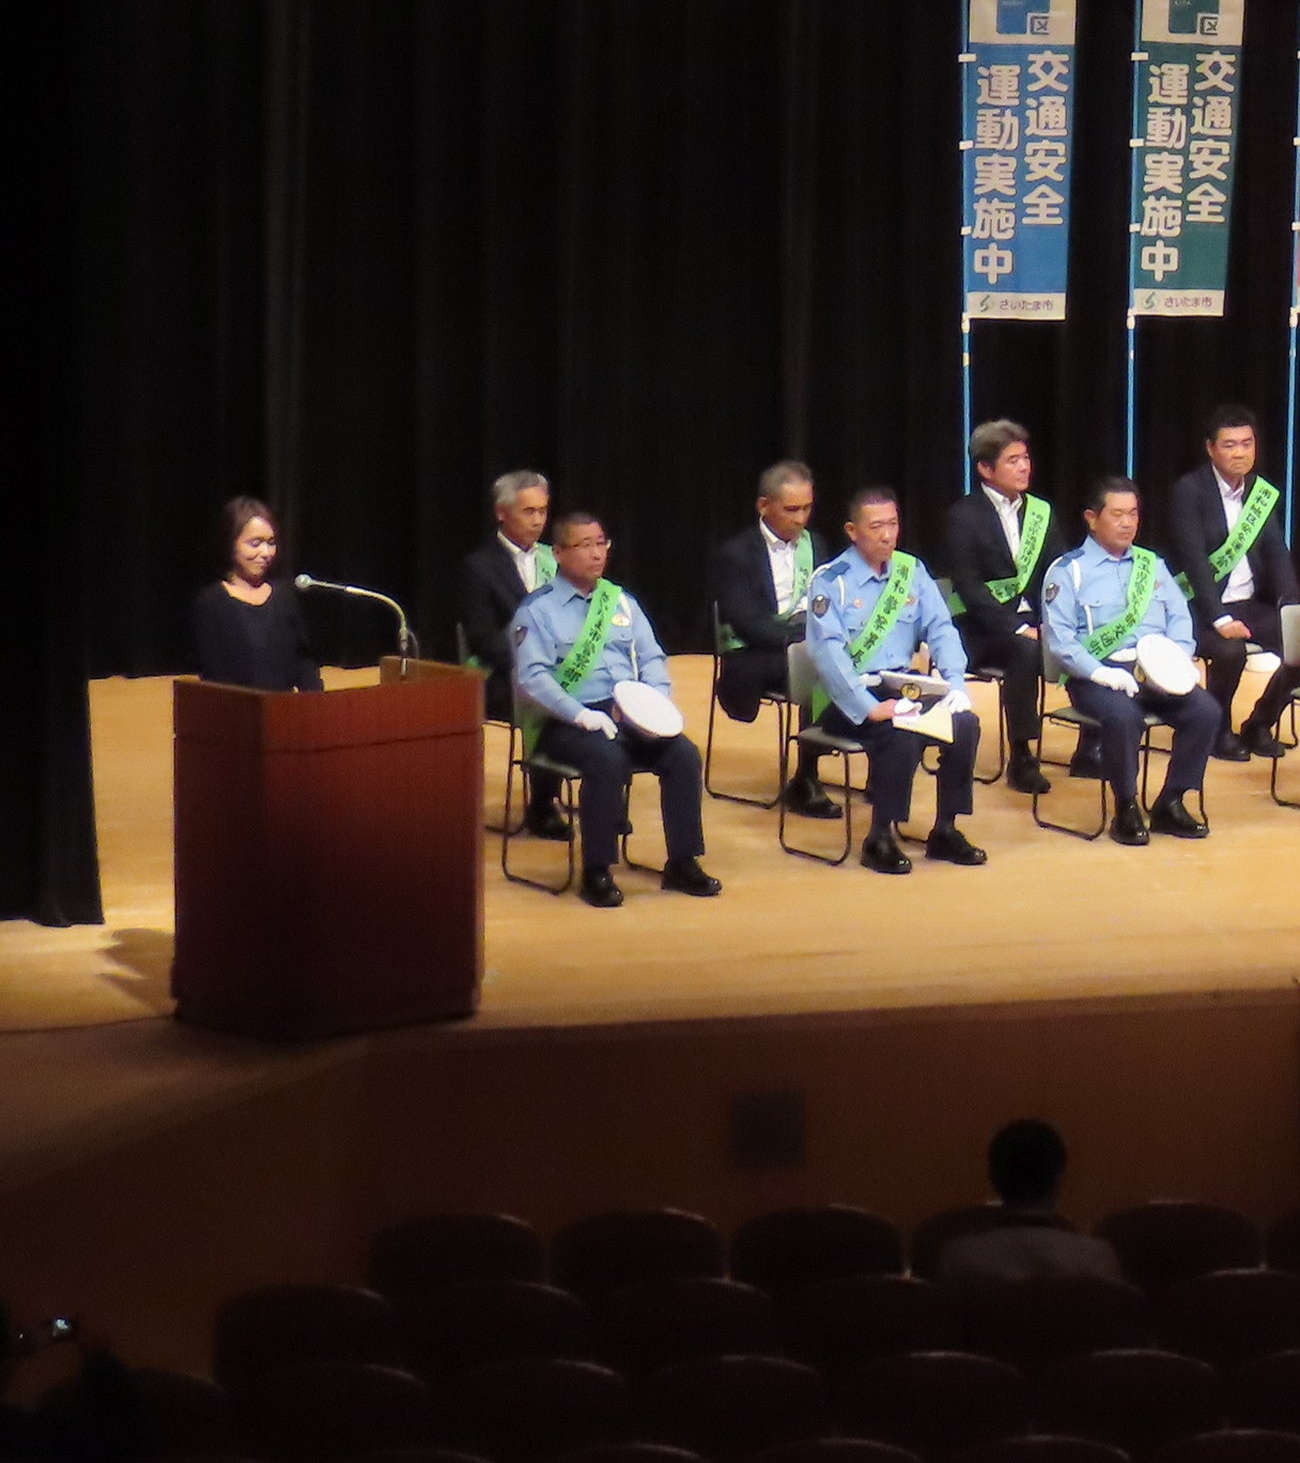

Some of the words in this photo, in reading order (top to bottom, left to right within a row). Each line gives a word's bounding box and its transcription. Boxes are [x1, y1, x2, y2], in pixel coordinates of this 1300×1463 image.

[972, 64, 1021, 285] 運動実施中
[1023, 51, 1069, 225] 交通安全
[1140, 63, 1189, 283] 運動実施中
[1186, 51, 1236, 223] 交通安全
[999, 297, 1054, 312] さいたま市
[1164, 295, 1212, 309] さいたま市
